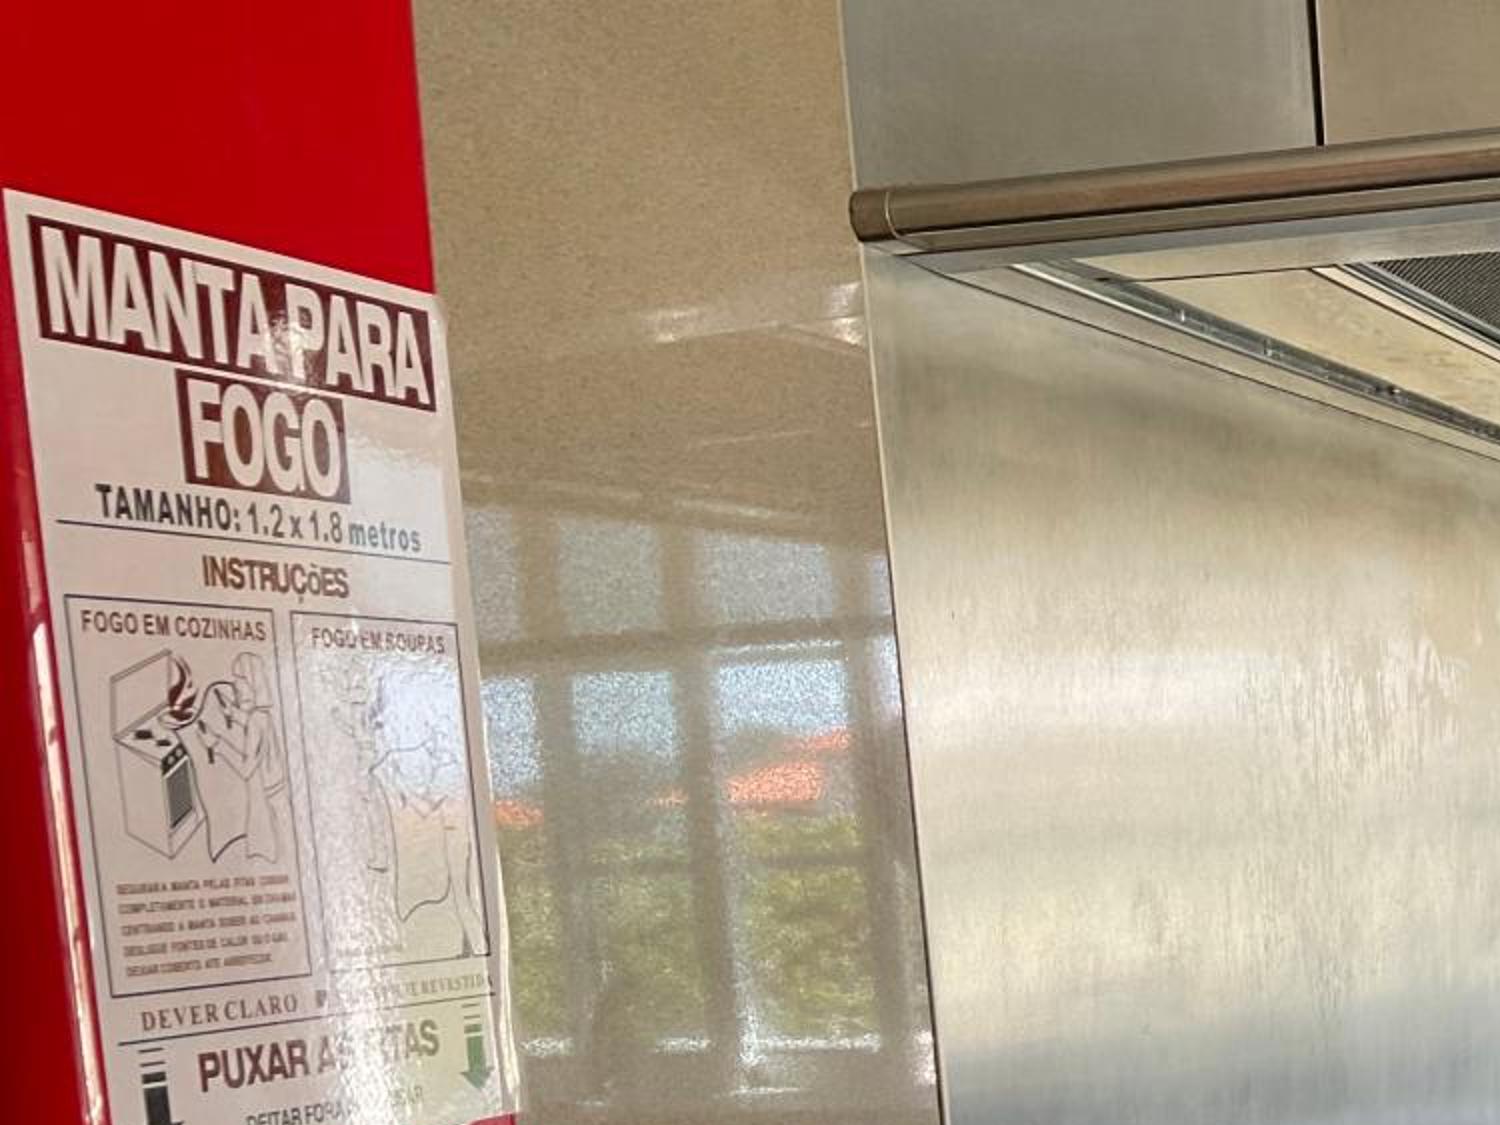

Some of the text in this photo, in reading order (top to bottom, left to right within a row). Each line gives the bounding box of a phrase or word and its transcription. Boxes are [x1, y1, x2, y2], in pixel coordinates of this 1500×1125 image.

[40, 225, 431, 406] MANTA PARA
[186, 377, 342, 497] FOGO
[95, 483, 422, 553] TAMANHO: 1.2 x 1.8 metros
[80, 609, 267, 642] FOGO EM COZINHAS
[311, 626, 357, 649] FOGO
[359, 628, 382, 650] EM
[141, 1002, 220, 1032] DEVER
[223, 993, 298, 1021] CLARO
[197, 1038, 311, 1093] PUXAR
[366, 1018, 441, 1063] TAS
[305, 1098, 346, 1125] FORA
